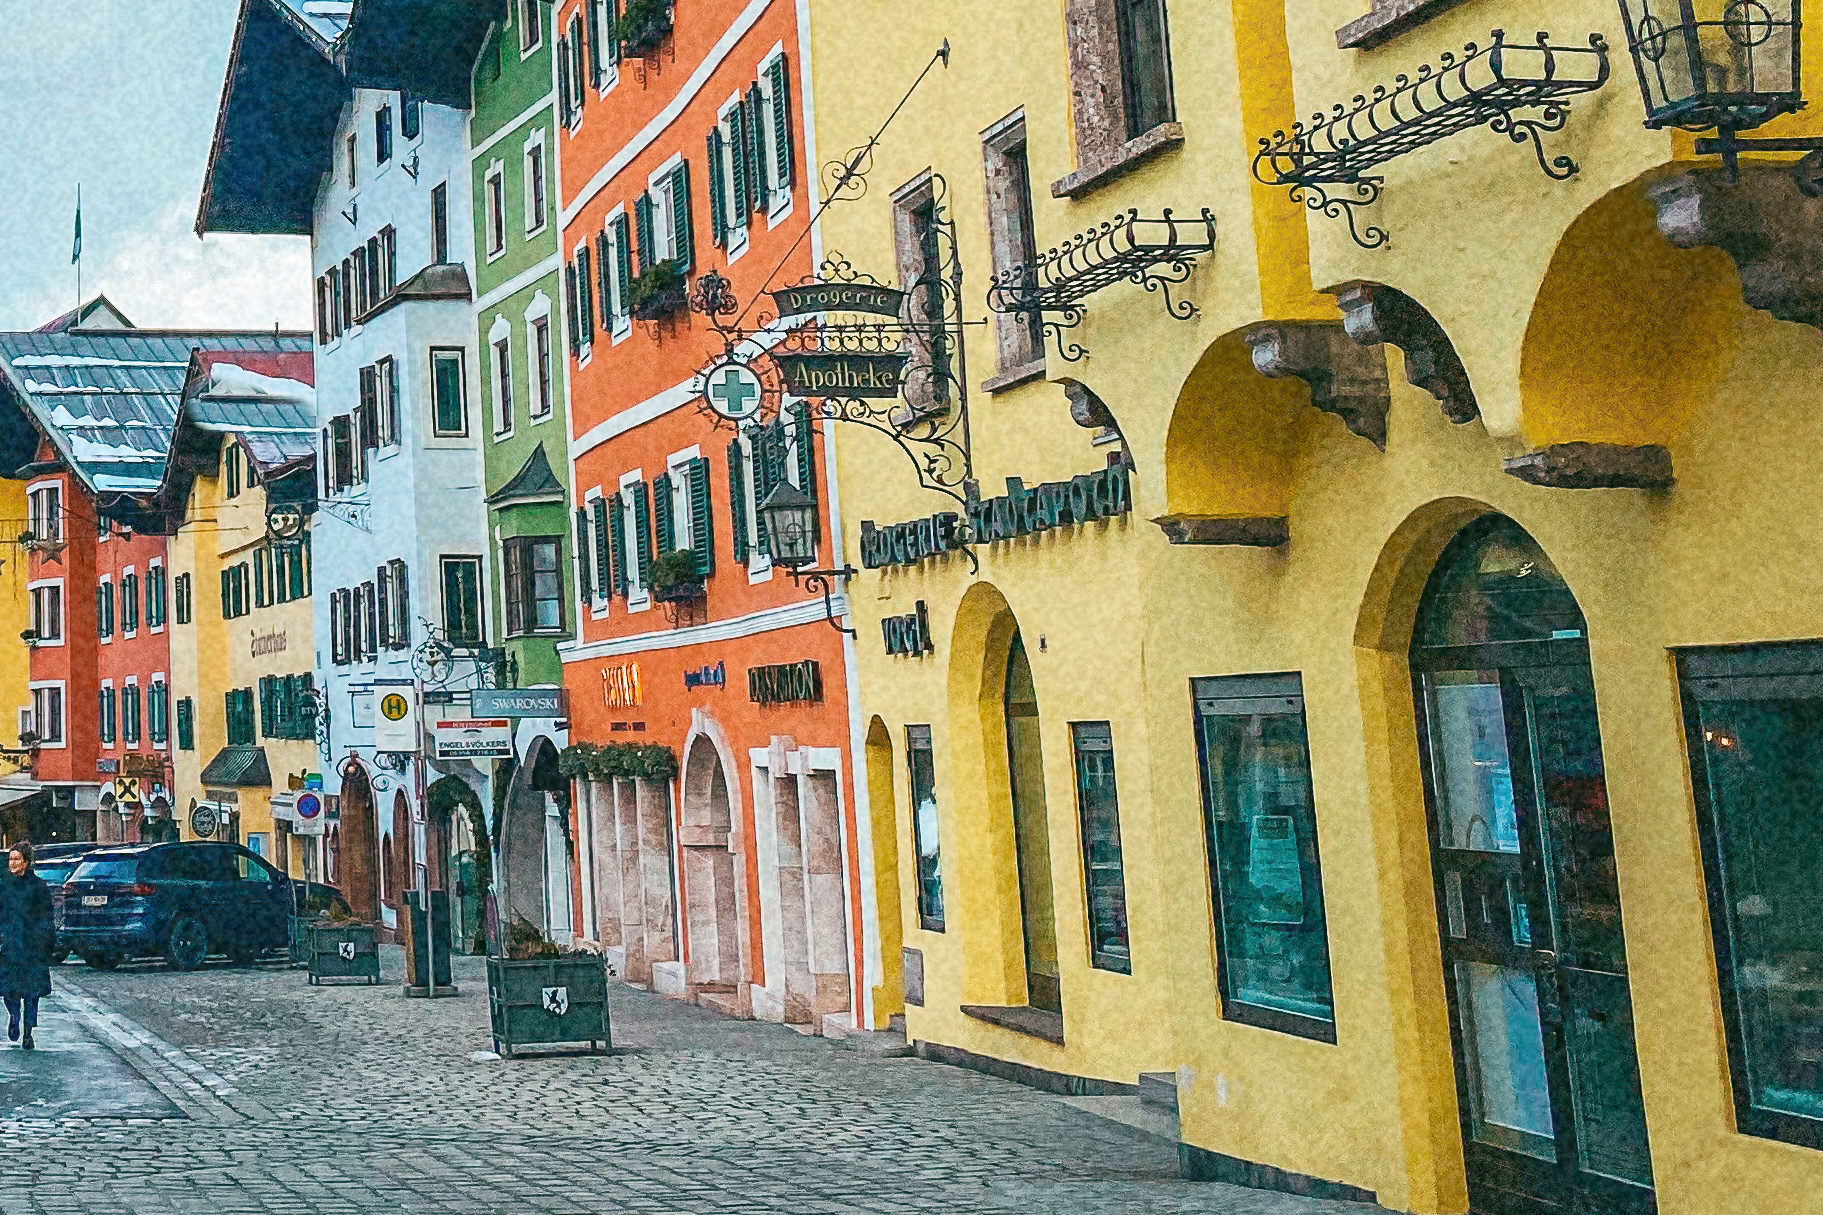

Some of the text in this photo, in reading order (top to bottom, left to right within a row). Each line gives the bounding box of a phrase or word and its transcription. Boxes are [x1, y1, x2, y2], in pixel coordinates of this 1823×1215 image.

[789, 290, 888, 309] Drogerie
[794, 360, 894, 390] Apotheke
[492, 697, 559, 710] SWAROVSKI
